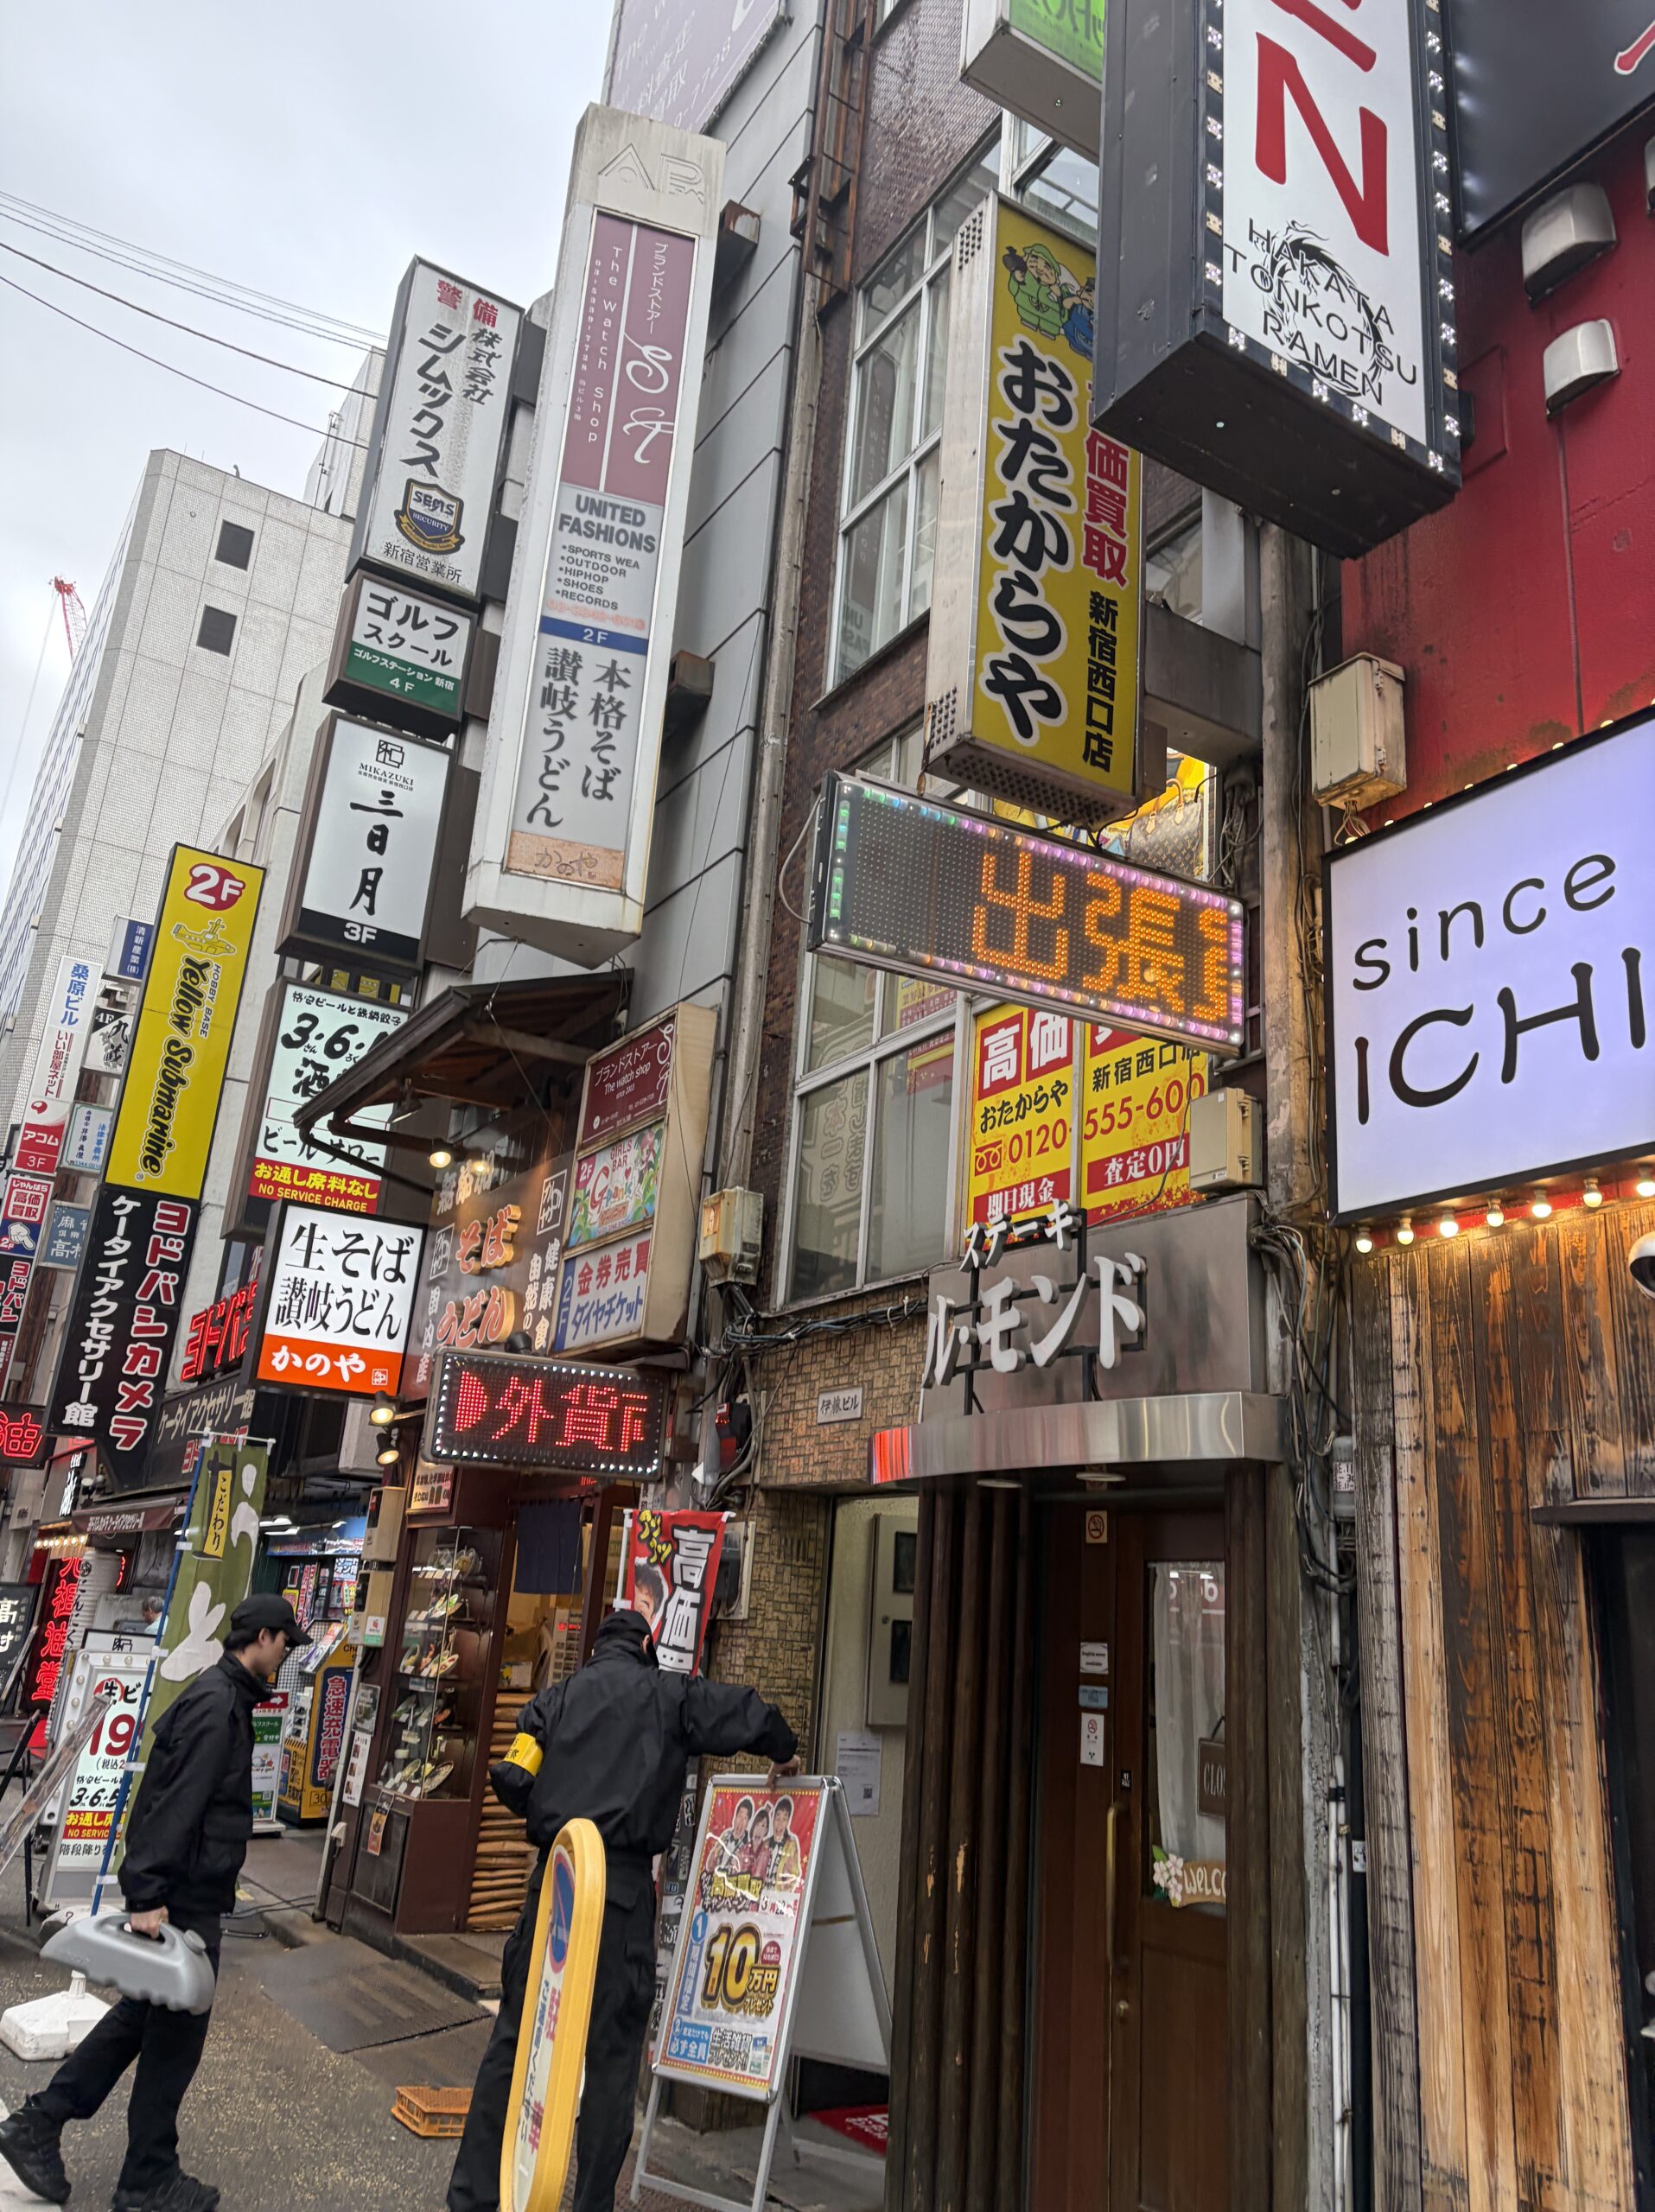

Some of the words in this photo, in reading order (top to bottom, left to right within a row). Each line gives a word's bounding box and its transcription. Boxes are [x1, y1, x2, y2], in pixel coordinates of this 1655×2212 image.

[1255, 0, 1390, 257] N
[608, 246, 622, 286] The
[1249, 218, 1395, 334] HAKATA
[436, 278, 499, 328] 警備
[1224, 242, 1417, 385] TONKOTSU
[461, 327, 503, 406] 株式会社
[1263, 311, 1383, 404] RAMEN
[399, 322, 467, 478] シムックス
[412, 489, 455, 517] SEMS
[1082, 381, 1130, 588] 価買取
[412, 512, 449, 532] SECURITY
[558, 513, 656, 554] FASHIONS
[575, 493, 646, 528] UNITED
[383, 541, 462, 584] 新宿営業所
[567, 544, 612, 563] SPORTS
[983, 340, 1073, 743] おたからや
[563, 567, 609, 584] HIPHOP
[563, 577, 604, 595] SHOES
[565, 555, 627, 578] OUTDOOR
[366, 590, 461, 641] ゴルフ
[560, 589, 620, 611] RECORDS
[363, 622, 453, 668] スクール
[582, 627, 608, 644] 2F
[353, 647, 432, 683] ゴルフステーション
[434, 674, 455, 692] 新宿
[1082, 590, 1117, 772] 新宿西口店
[581, 658, 633, 802] 本格そば
[359, 762, 415, 786] MIKAZUKI
[349, 789, 404, 917] 三日月
[185, 865, 246, 908] 2F
[343, 921, 379, 945] 3F
[1351, 854, 1618, 991] since
[59, 962, 90, 1027] 桑原ビル
[170, 956, 212, 1038] Yellow
[209, 963, 221, 1003] HOBBY
[95, 1012, 115, 1026] 4F
[200, 1007, 213, 1039] BASE
[1353, 946, 1647, 1126] ICHI
[44, 1029, 68, 1097] いい部屋ネット
[595, 1041, 658, 1088] ブランドストアー
[603, 1081, 615, 1096] The
[616, 1070, 635, 1090] watch
[635, 1061, 652, 1078] shop
[143, 1037, 194, 1175] Submarine
[980, 1077, 1070, 1135] おたからや
[22, 1130, 60, 1147] アコム
[27, 1155, 47, 1169] 3F
[610, 1139, 633, 1160] GIRLS
[254, 1162, 378, 1200] お通し席料なし
[578, 1161, 594, 1183] 2F
[612, 1154, 629, 1173] BAR
[258, 1183, 275, 1196] NO
[277, 1187, 322, 1205] SERVICE
[324, 1196, 368, 1213] CHARGE
[986, 1176, 1056, 1219] 即日現金
[285, 1220, 415, 1286] 生そば
[455, 1204, 520, 1275] そば
[958, 1198, 1074, 1273] ステーキ
[576, 1241, 651, 1297] 金券売買
[61, 1195, 142, 1427] ケータイアクセサリー館
[436, 1284, 510, 1350] うどん
[534, 1236, 561, 1351] 健康食
[558, 1274, 574, 1330] 2F
[570, 1285, 644, 1342] ダイヤチケット
[109, 1200, 192, 1452] ヨドバシカメラ
[921, 1251, 1146, 1389] ル・モンド
[271, 1345, 366, 1384] かのや
[156, 1382, 258, 1445] ケータイアクセサリー館
[820, 1389, 860, 1415] 伊藤ビル
[210, 1475, 229, 1554] こだわり
[76, 1774, 123, 1785] 格安ビール
[68, 1828, 80, 1838] NO
[80, 1828, 110, 1839] SERVIC
